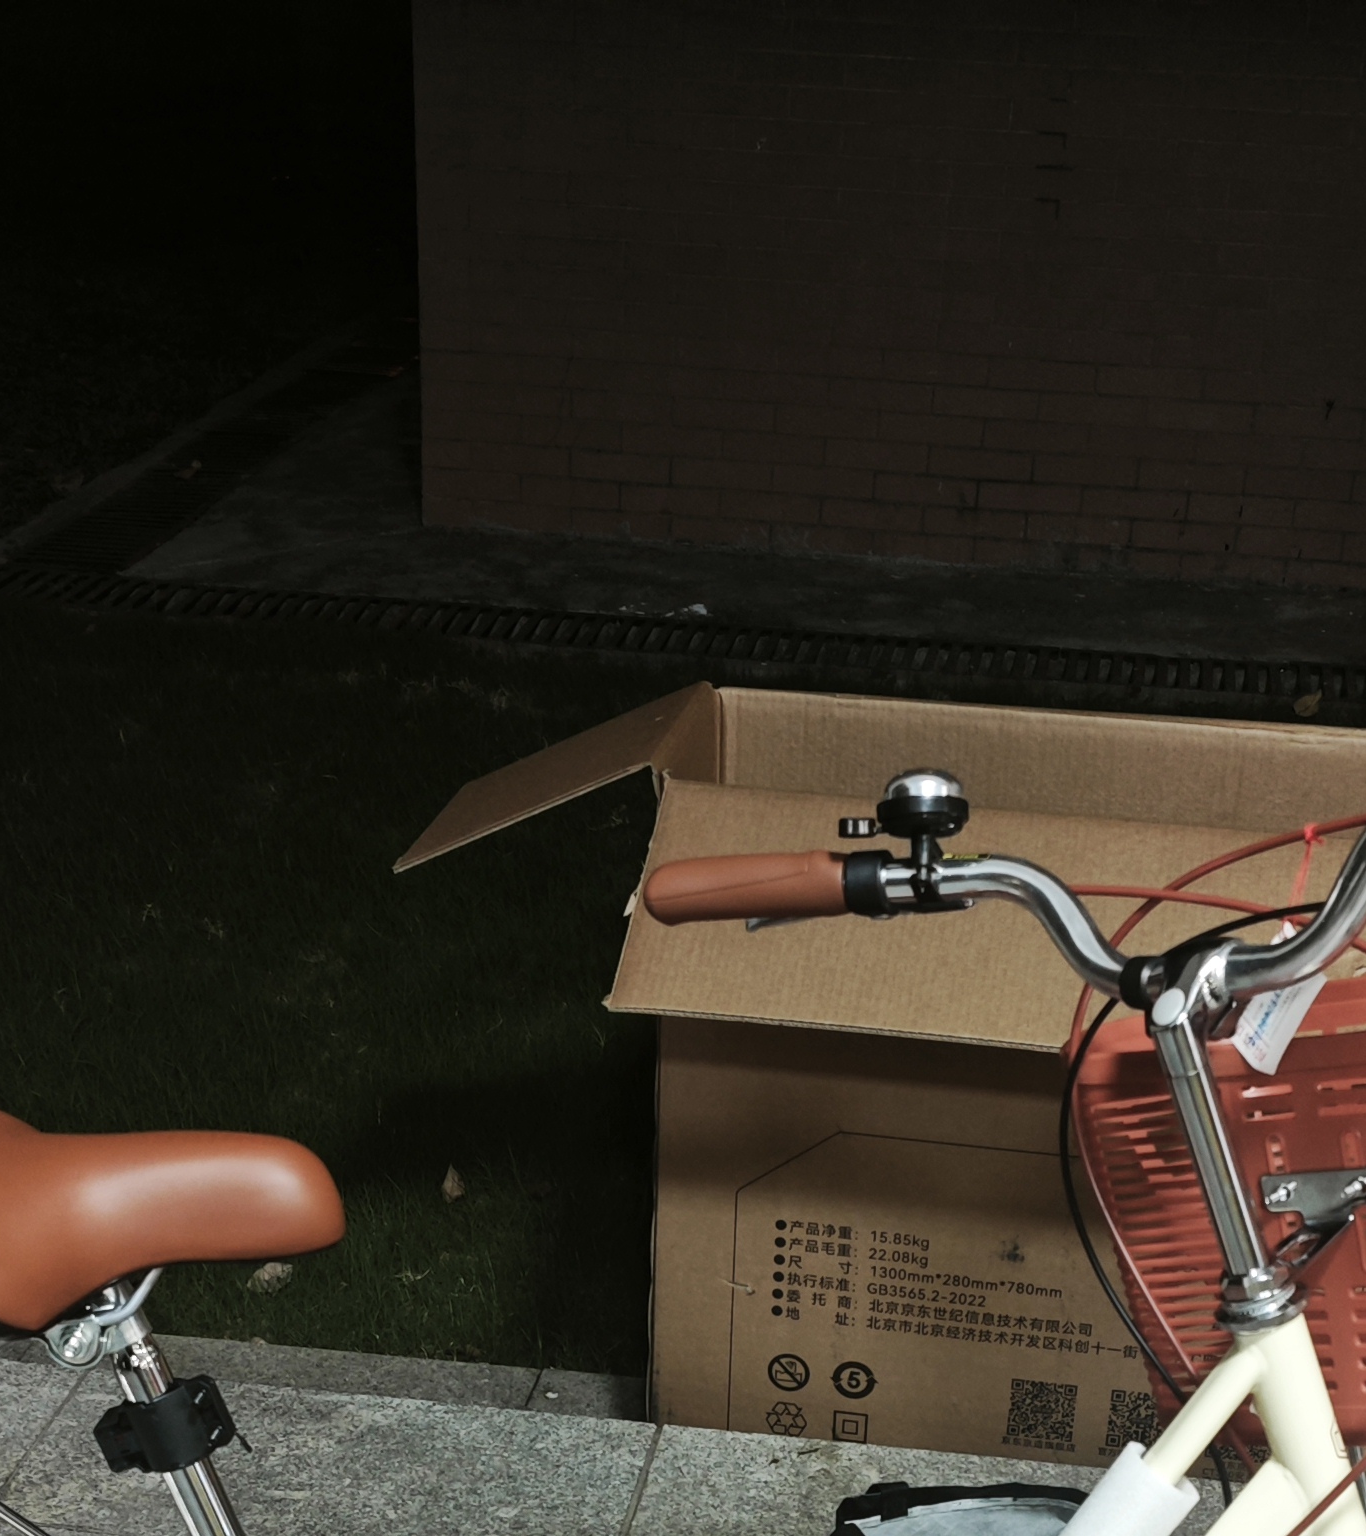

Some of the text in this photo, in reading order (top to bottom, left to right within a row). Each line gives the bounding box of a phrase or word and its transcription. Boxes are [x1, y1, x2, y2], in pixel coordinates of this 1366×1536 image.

[788, 1238, 929, 1269] 产品毛重： 22.08kg
[789, 1220, 930, 1251] 产品净重： 15.85kg
[787, 1272, 987, 1308] 执行标准： GB3565.2-2022
[868, 1299, 1093, 1338] 北京京东世纪信息技术有限公司
[866, 1315, 1139, 1360] 北京市北京经济技术开发区科创十一街
